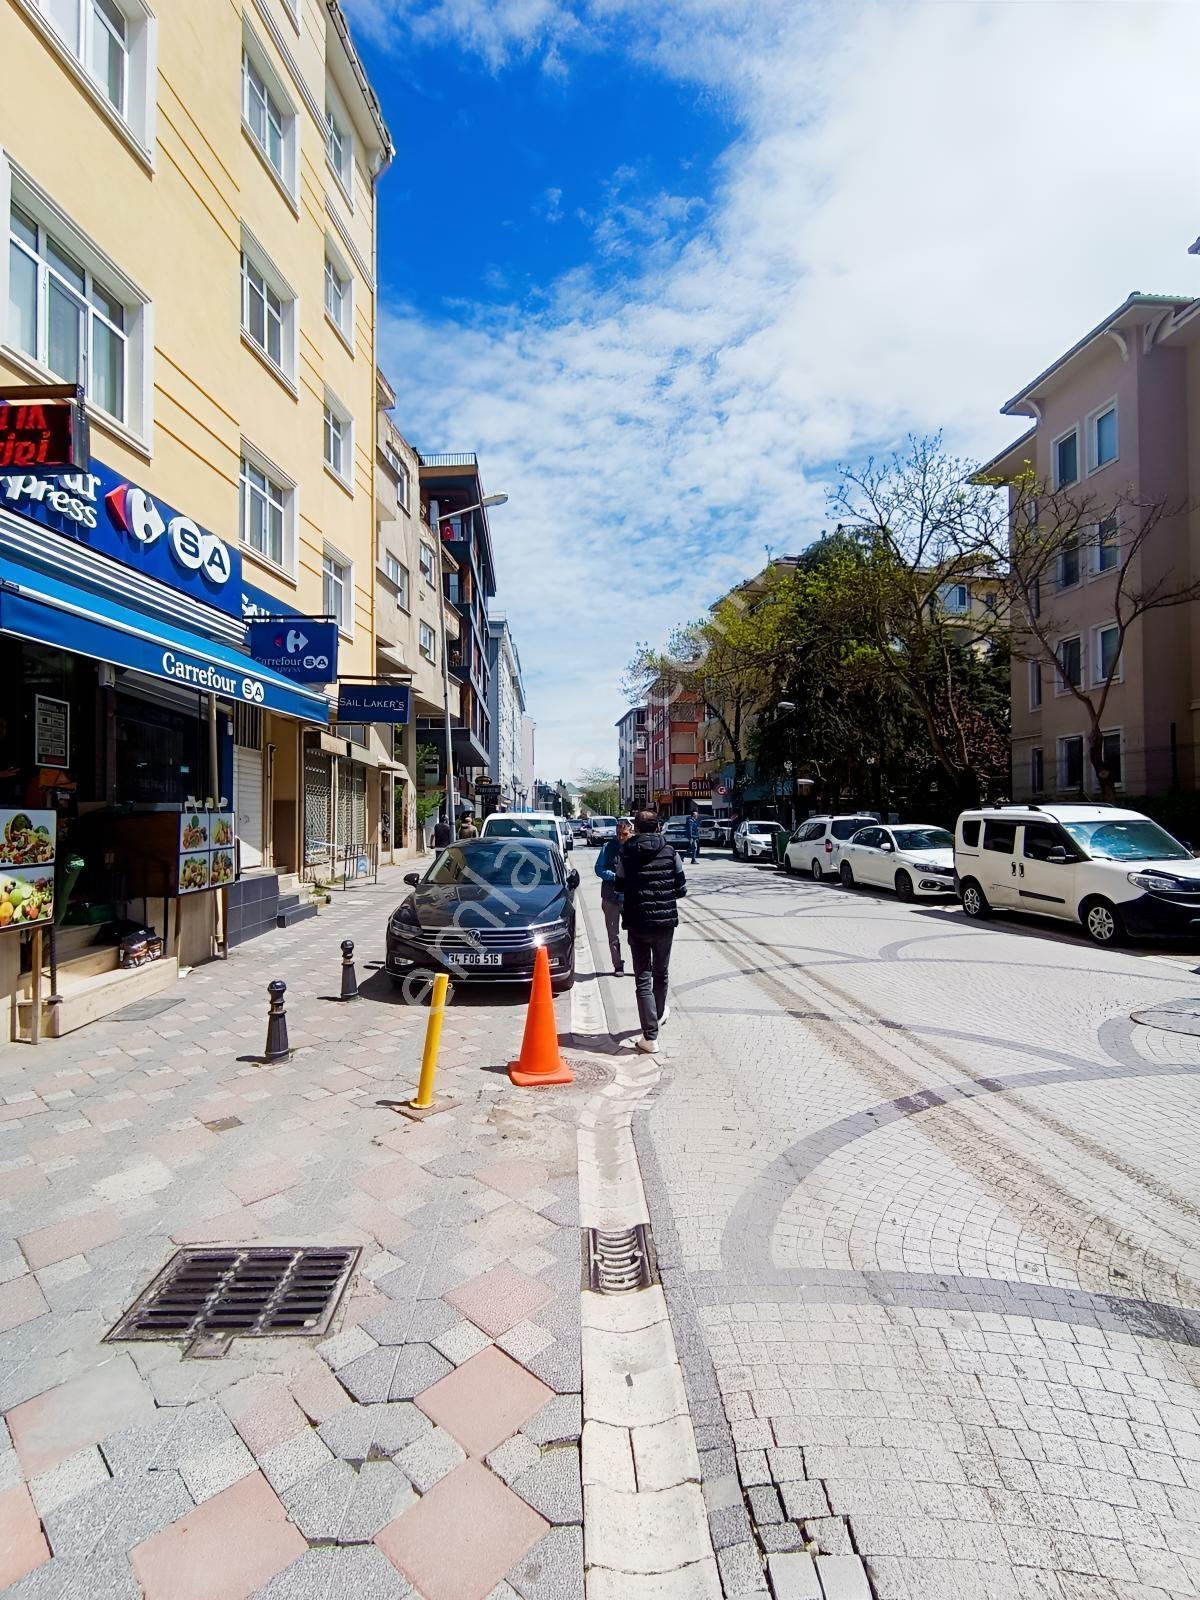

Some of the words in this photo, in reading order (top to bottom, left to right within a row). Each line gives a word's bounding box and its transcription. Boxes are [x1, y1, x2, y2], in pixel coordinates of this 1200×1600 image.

[175, 521, 229, 580] SA
[162, 652, 236, 693] Carrefour
[243, 680, 264, 701] SA
[449, 954, 460, 964] 34
[483, 954, 499, 964] 516
